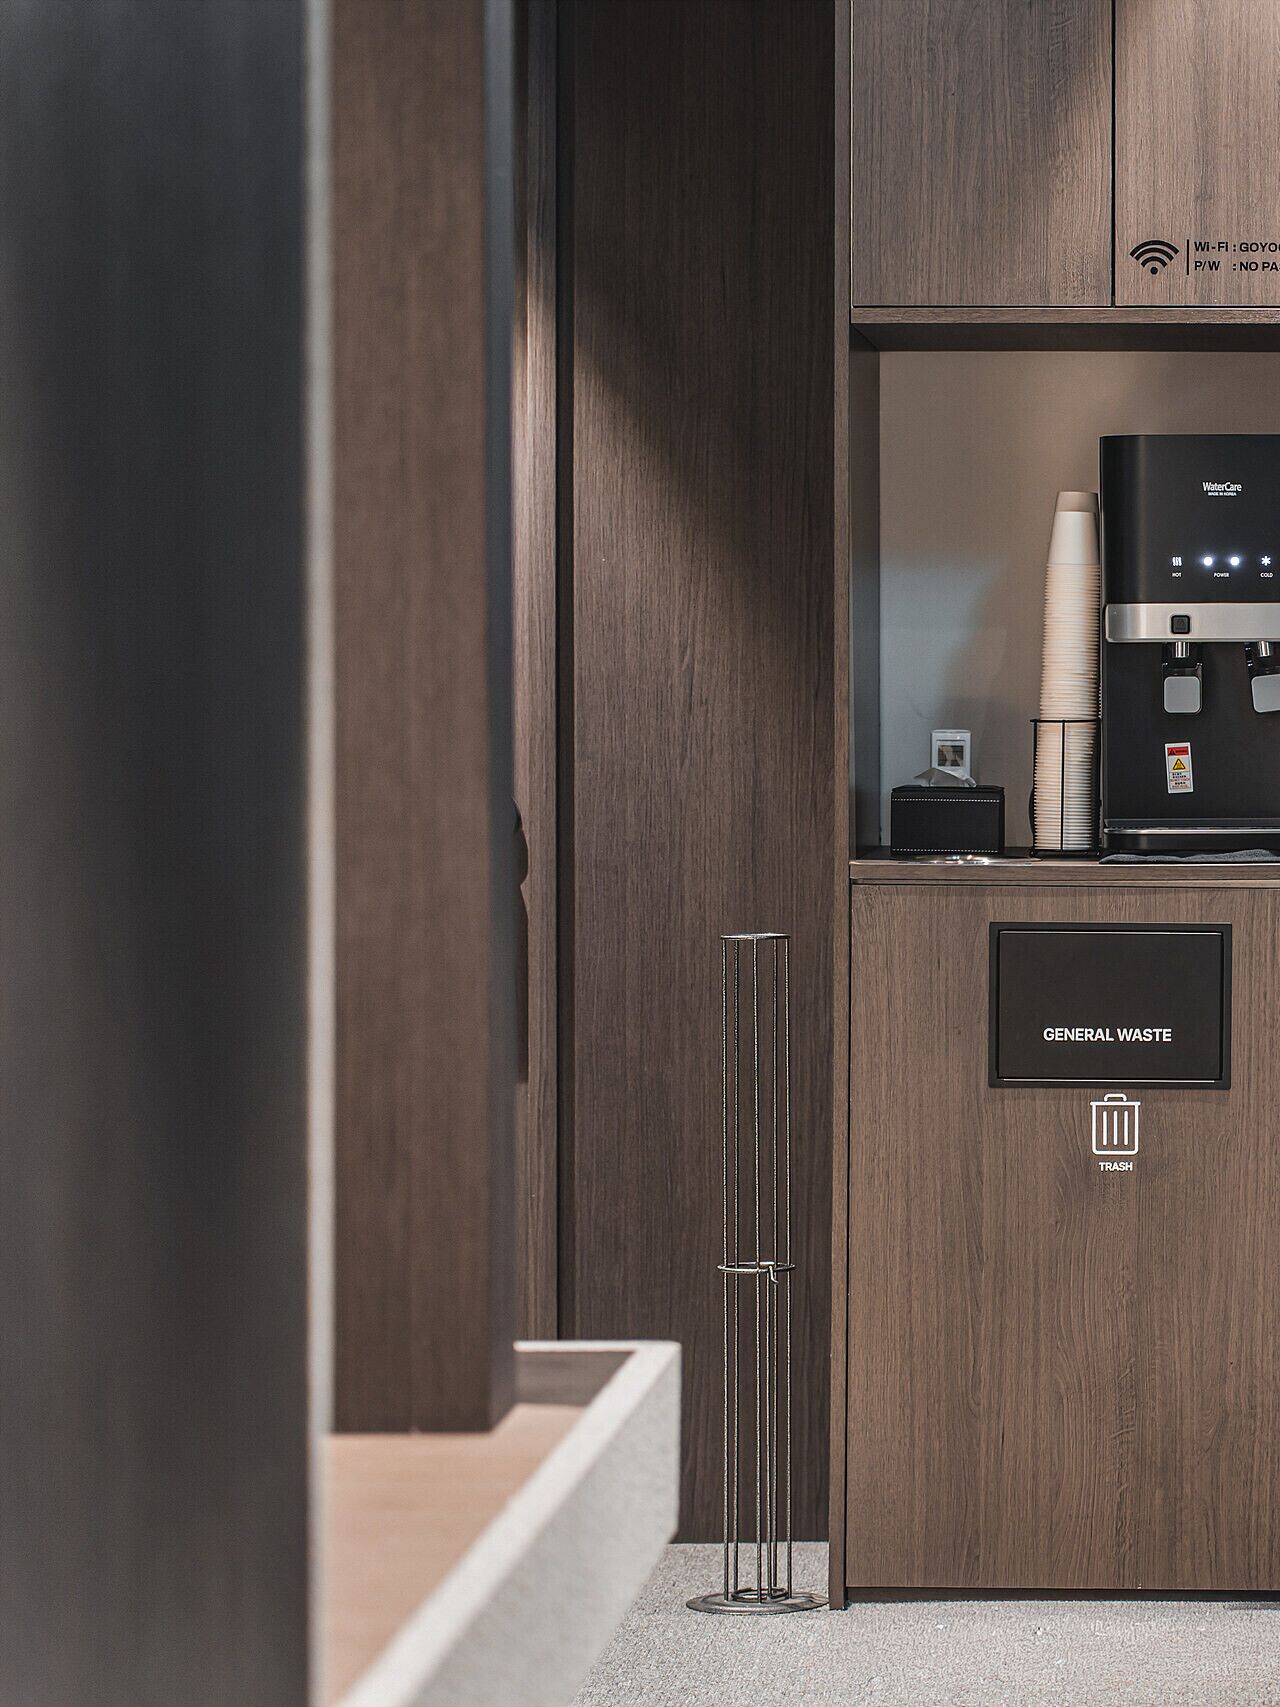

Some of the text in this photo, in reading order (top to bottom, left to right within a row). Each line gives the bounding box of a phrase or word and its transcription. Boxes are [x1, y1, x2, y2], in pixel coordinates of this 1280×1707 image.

[1194, 241, 1228, 252] Wi-Fi
[1194, 260, 1220, 271] P/W
[1240, 261, 1258, 272] NO
[1203, 481, 1242, 492] WaterCare
[1043, 1027, 1172, 1042] GENERAL WASTE
[1099, 1161, 1132, 1171] TRASH
